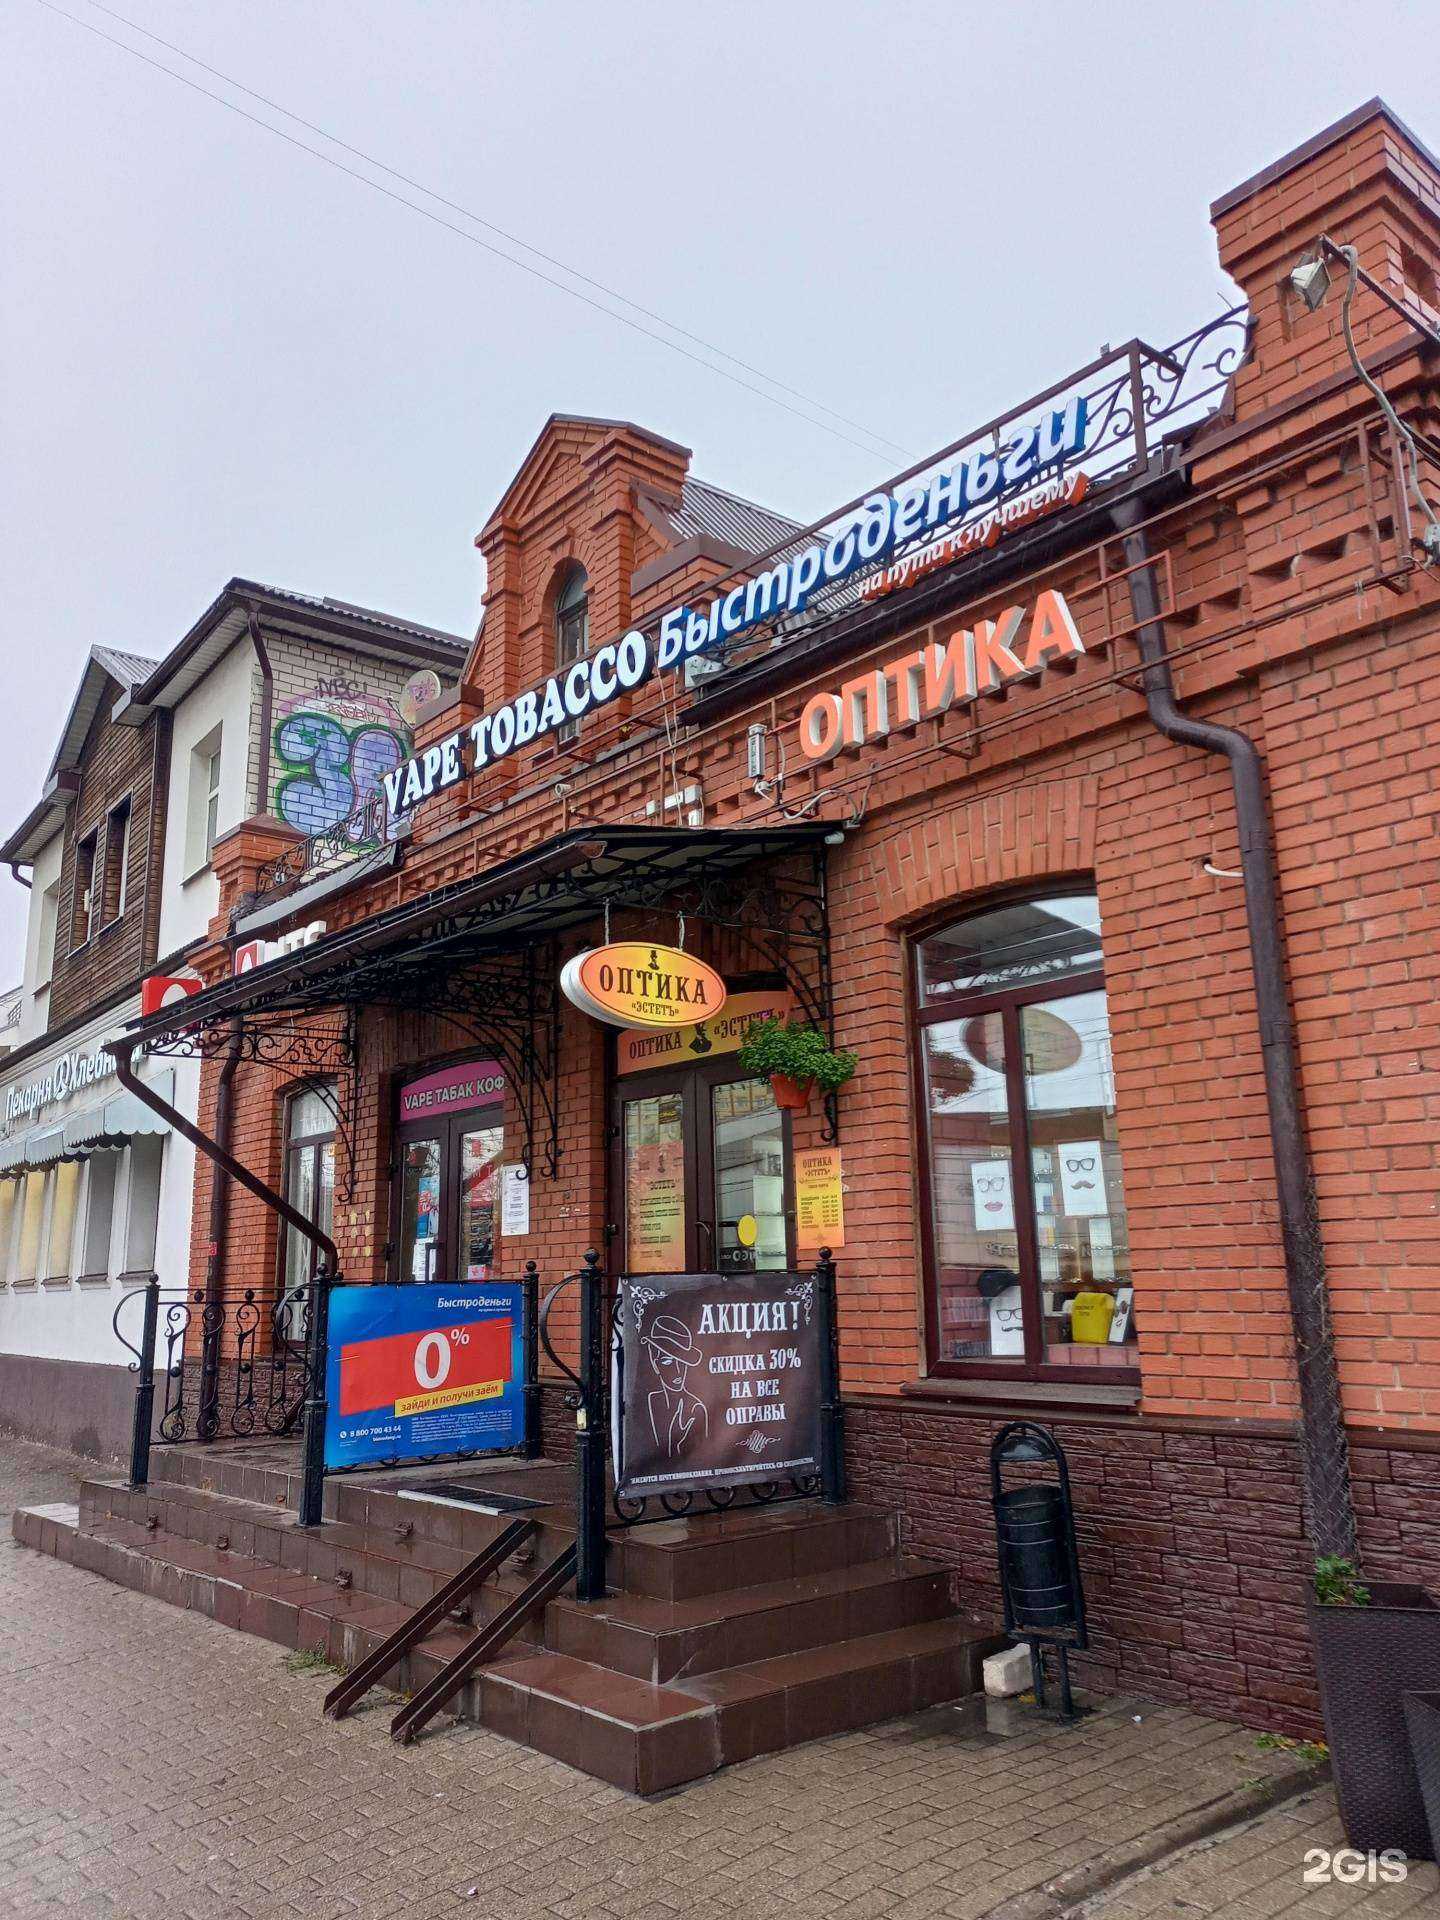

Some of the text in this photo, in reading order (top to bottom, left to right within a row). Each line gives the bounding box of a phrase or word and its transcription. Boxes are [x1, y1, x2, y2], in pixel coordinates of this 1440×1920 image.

[658, 396, 1084, 669] Быстроденьги
[858, 472, 1082, 598] на пути к лучшему
[800, 589, 1085, 760] ОПТИКА
[384, 734, 461, 815] VAPE
[471, 630, 647, 768] TOBACCO
[599, 965, 708, 1005] ОПТИКА
[629, 1031, 683, 1059] ОПТИКА
[6, 1076, 51, 1121] Пекарня
[404, 1074, 508, 1110] VAPE ТАБАК КОФ
[437, 1296, 512, 1309] Быстроденьги
[414, 1326, 470, 1389] 0%
[708, 1348, 802, 1375] СКИДКА 30%
[400, 1385, 498, 1413] зайди и получи заём
[731, 1379, 780, 1399] НА ВСЕ
[726, 1403, 786, 1425] ОПРАВЫ
